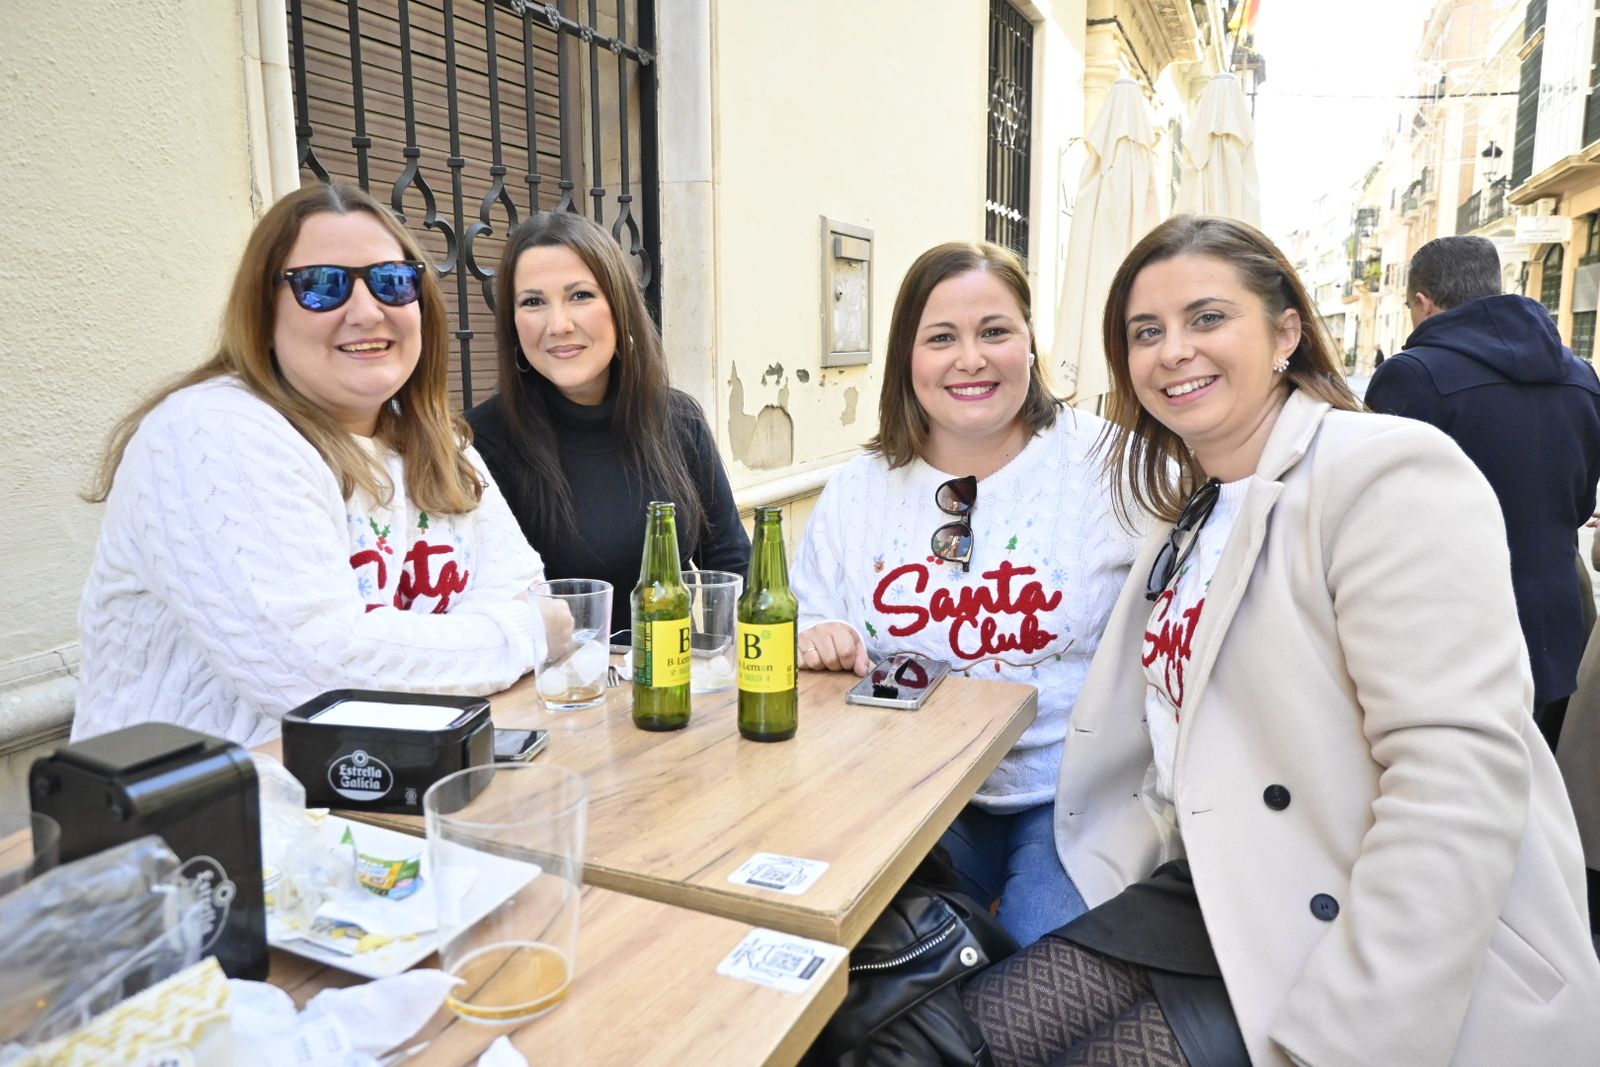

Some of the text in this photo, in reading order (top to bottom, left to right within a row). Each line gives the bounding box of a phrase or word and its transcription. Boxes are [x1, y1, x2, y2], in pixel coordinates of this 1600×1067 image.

[872, 560, 1063, 638] Santa
[679, 627, 691, 654] B
[743, 633, 762, 660] B
[949, 613, 1058, 661] Club
[339, 763, 382, 778] Estrella
[340, 775, 381, 790] Galicia
